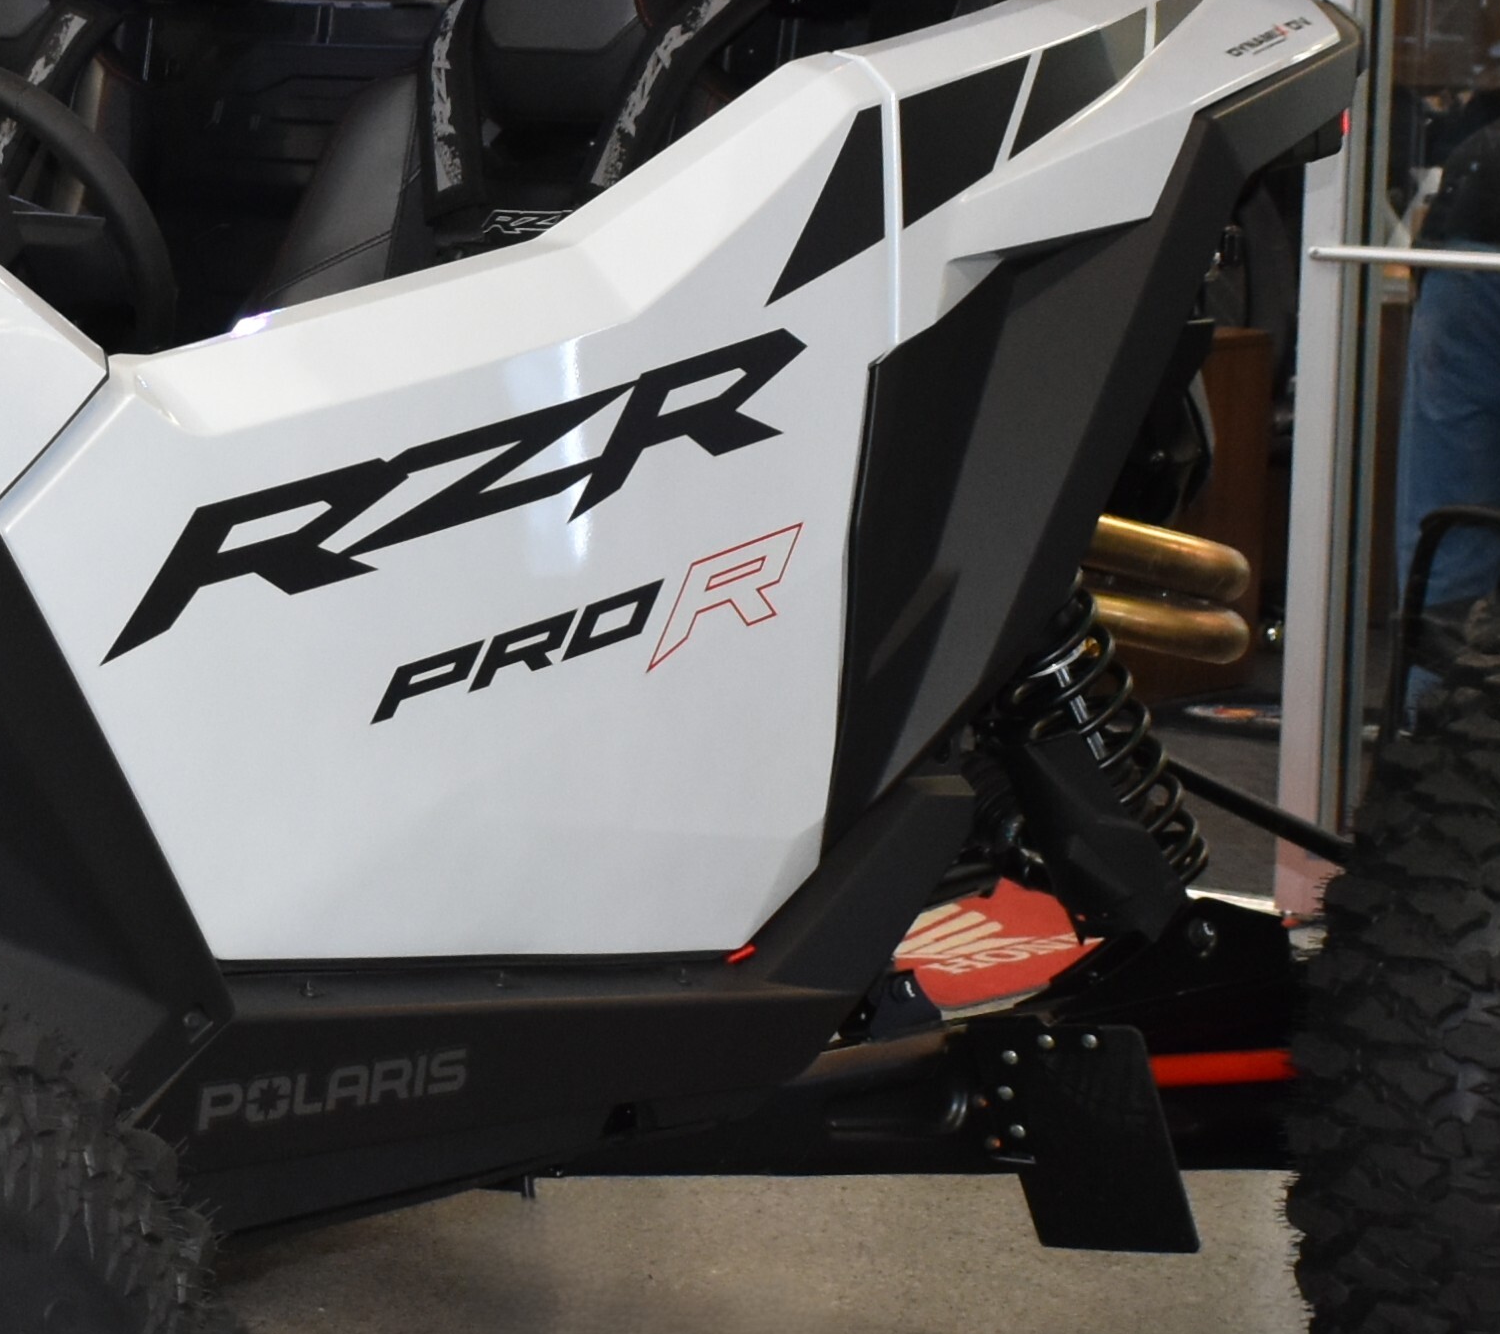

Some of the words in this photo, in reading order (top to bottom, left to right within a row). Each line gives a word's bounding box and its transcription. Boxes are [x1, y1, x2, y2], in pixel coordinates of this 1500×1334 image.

[481, 209, 574, 234] RZ
[99, 328, 808, 667] RZR
[370, 578, 666, 726] PRO
[646, 522, 803, 673] R
[197, 1047, 467, 1132] POLARIS
